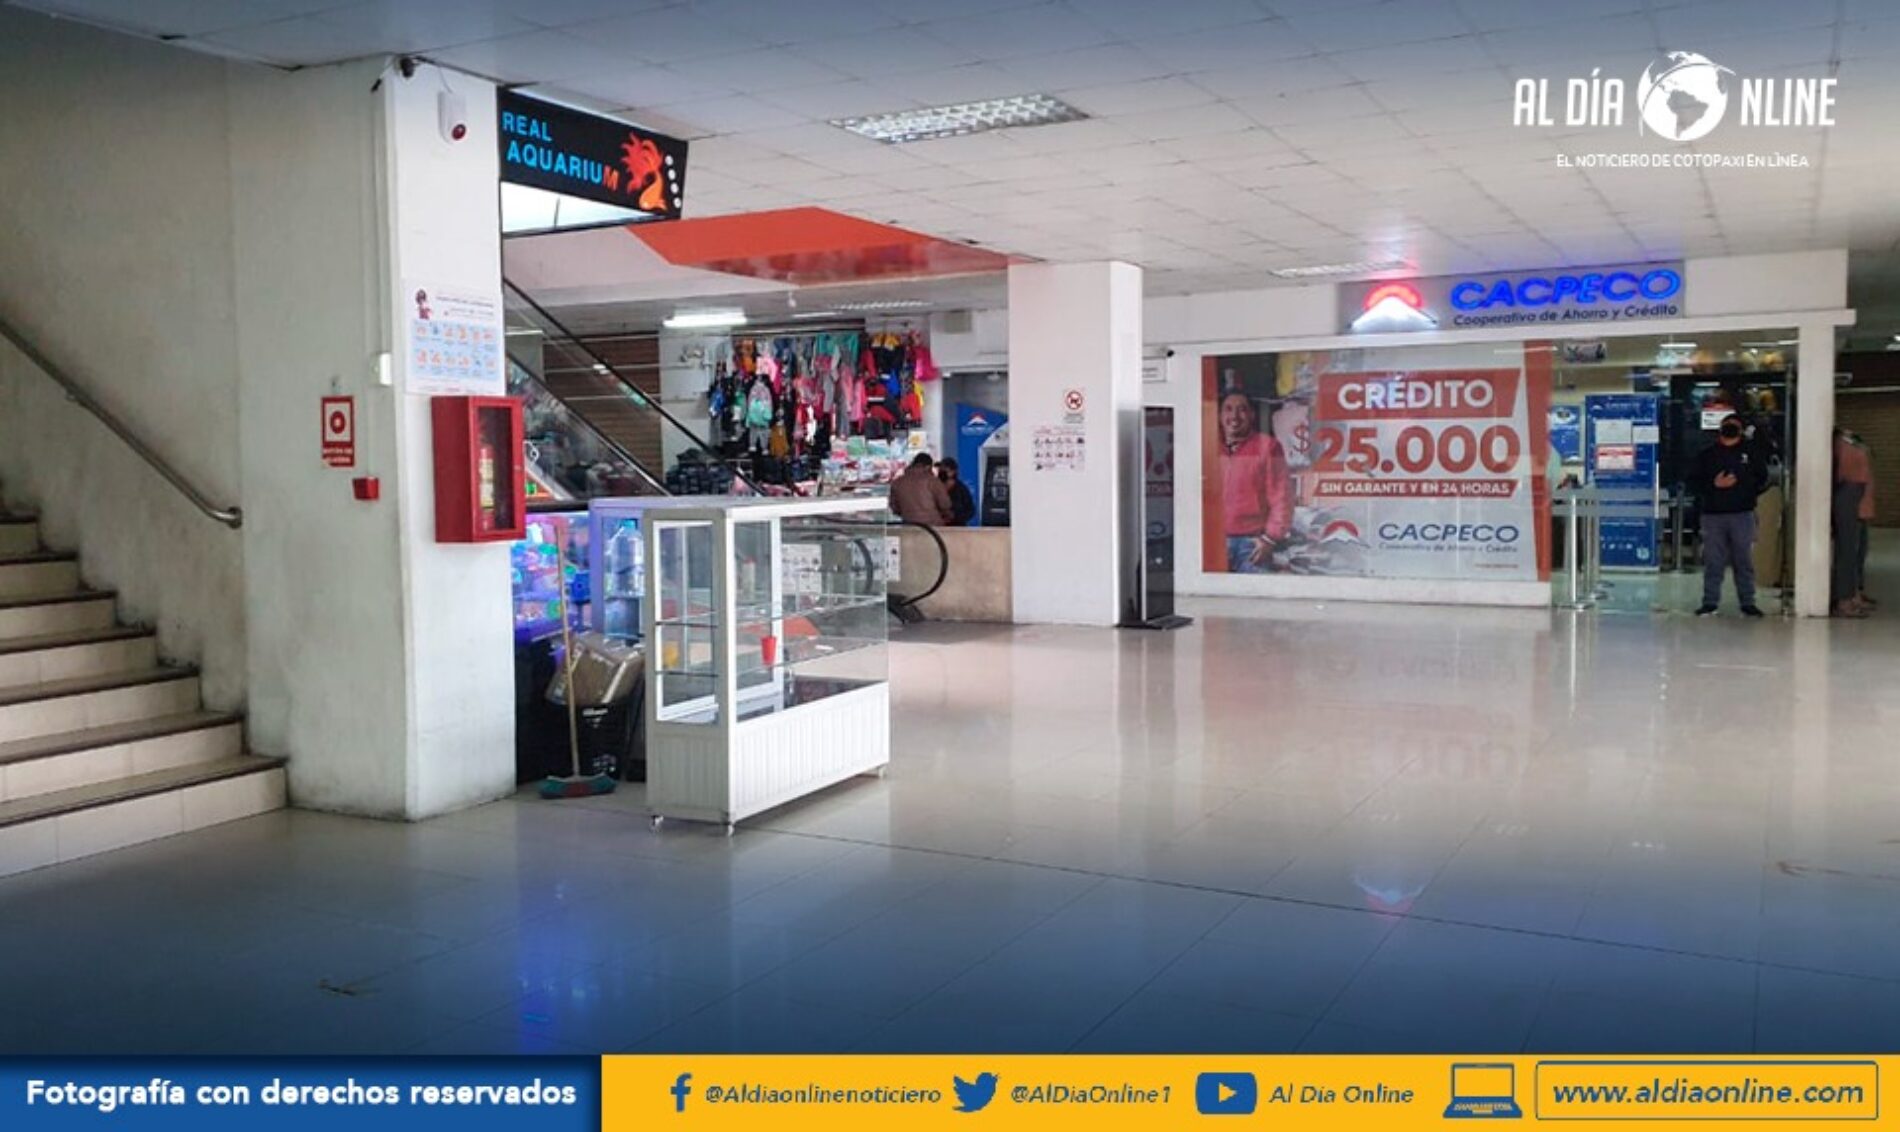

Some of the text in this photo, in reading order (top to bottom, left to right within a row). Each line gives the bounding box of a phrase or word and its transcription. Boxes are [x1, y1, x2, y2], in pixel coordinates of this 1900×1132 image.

[502, 111, 552, 142] REAL
[507, 140, 620, 192] AQUARIUM
[1451, 267, 1682, 311] CACPECO
[1453, 303, 1678, 327] Cooperativa de Ahorro y Crédito
[1338, 372, 1493, 411] CRÉDITO
[1320, 482, 1510, 495] SIN GARANTE Y EN 24 HORAS
[1378, 523, 1520, 543] CACPECO
